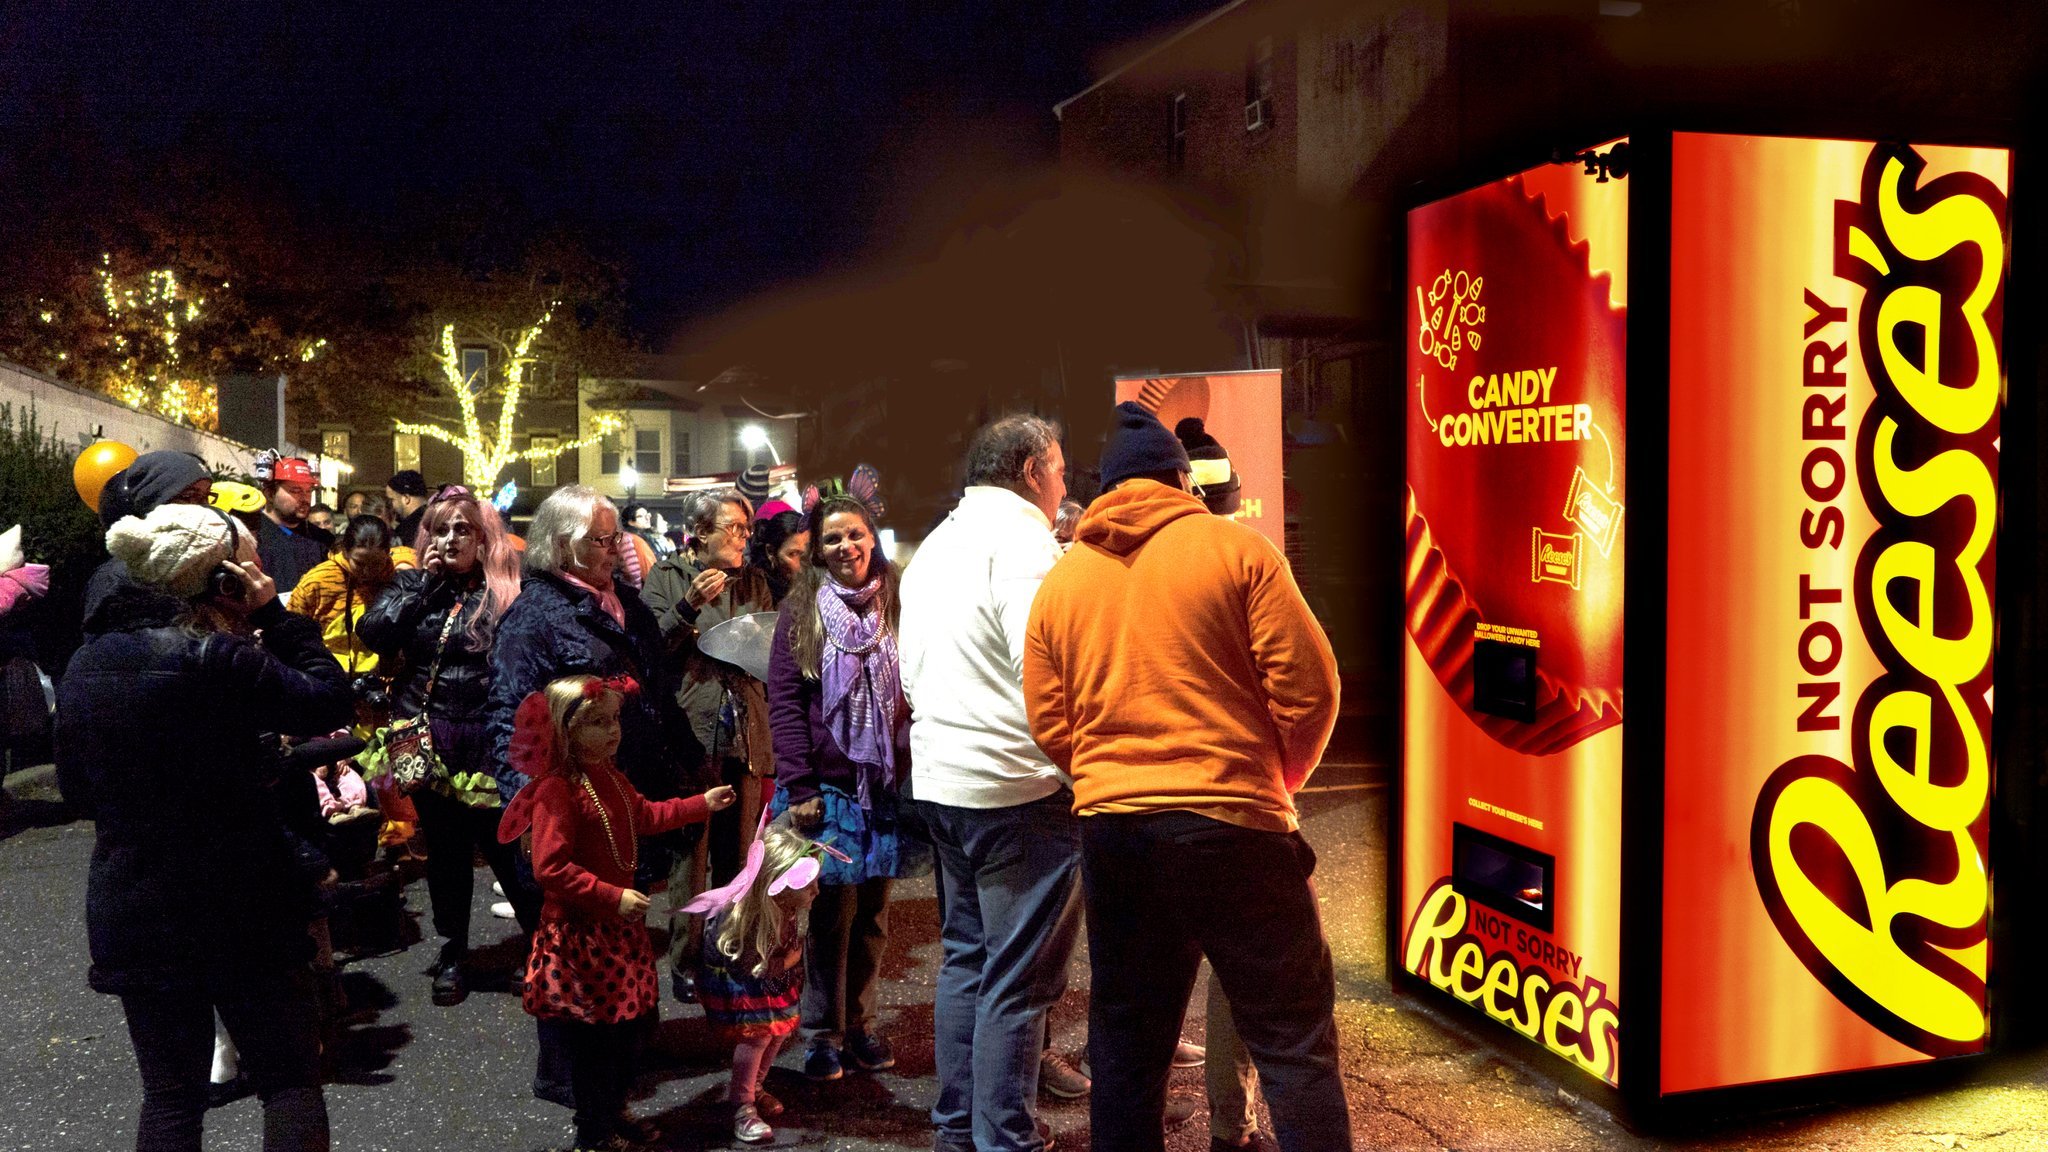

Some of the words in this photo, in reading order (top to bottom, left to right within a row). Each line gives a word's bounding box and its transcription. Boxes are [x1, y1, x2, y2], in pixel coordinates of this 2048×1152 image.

[1468, 366, 1558, 410] CANDY
[1439, 403, 1593, 448] CONVERTER
[1800, 286, 1848, 551] SORRY
[1769, 156, 2005, 1042] Reese's
[1474, 630, 1506, 642] HALLOWEEN
[1506, 636, 1526, 645] CANDY
[1526, 638, 1540, 648] HERE
[1476, 622, 1491, 632] DROP
[1492, 624, 1506, 634] YOUR
[1506, 627, 1538, 638] UNWANTED
[1797, 573, 1843, 734] NOT
[1468, 797, 1491, 812] COLLECT
[1491, 805, 1506, 818] YOUR
[1475, 908, 1512, 945] NOT
[1516, 928, 1583, 979] SORRY
[1405, 883, 1620, 1077] Reese's
